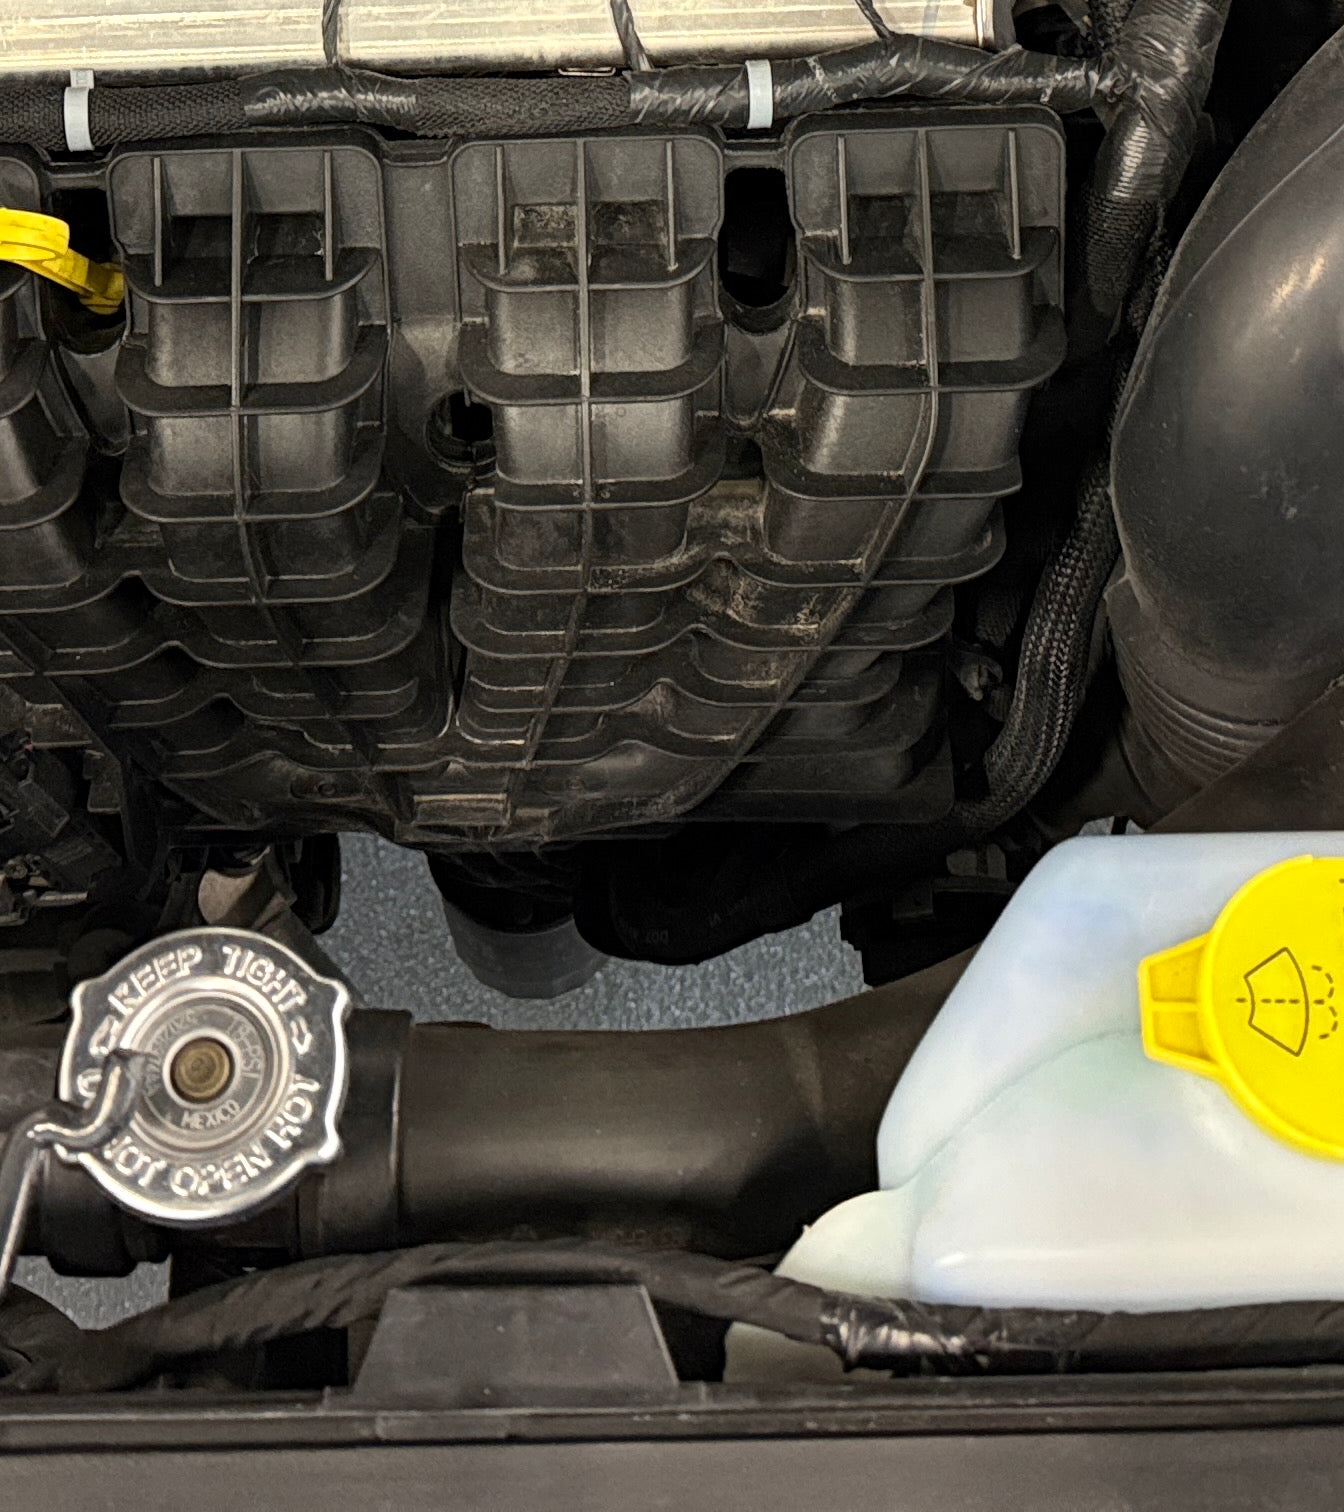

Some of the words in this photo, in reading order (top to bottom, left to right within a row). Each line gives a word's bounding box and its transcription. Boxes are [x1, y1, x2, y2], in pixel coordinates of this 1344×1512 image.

[107, 944, 204, 1017] KEEP
[221, 944, 308, 1014] TIGHT
[170, 1144, 274, 1197] OPEN
[263, 1072, 321, 1151] HOT
[180, 1099, 241, 1130] MEXICO
